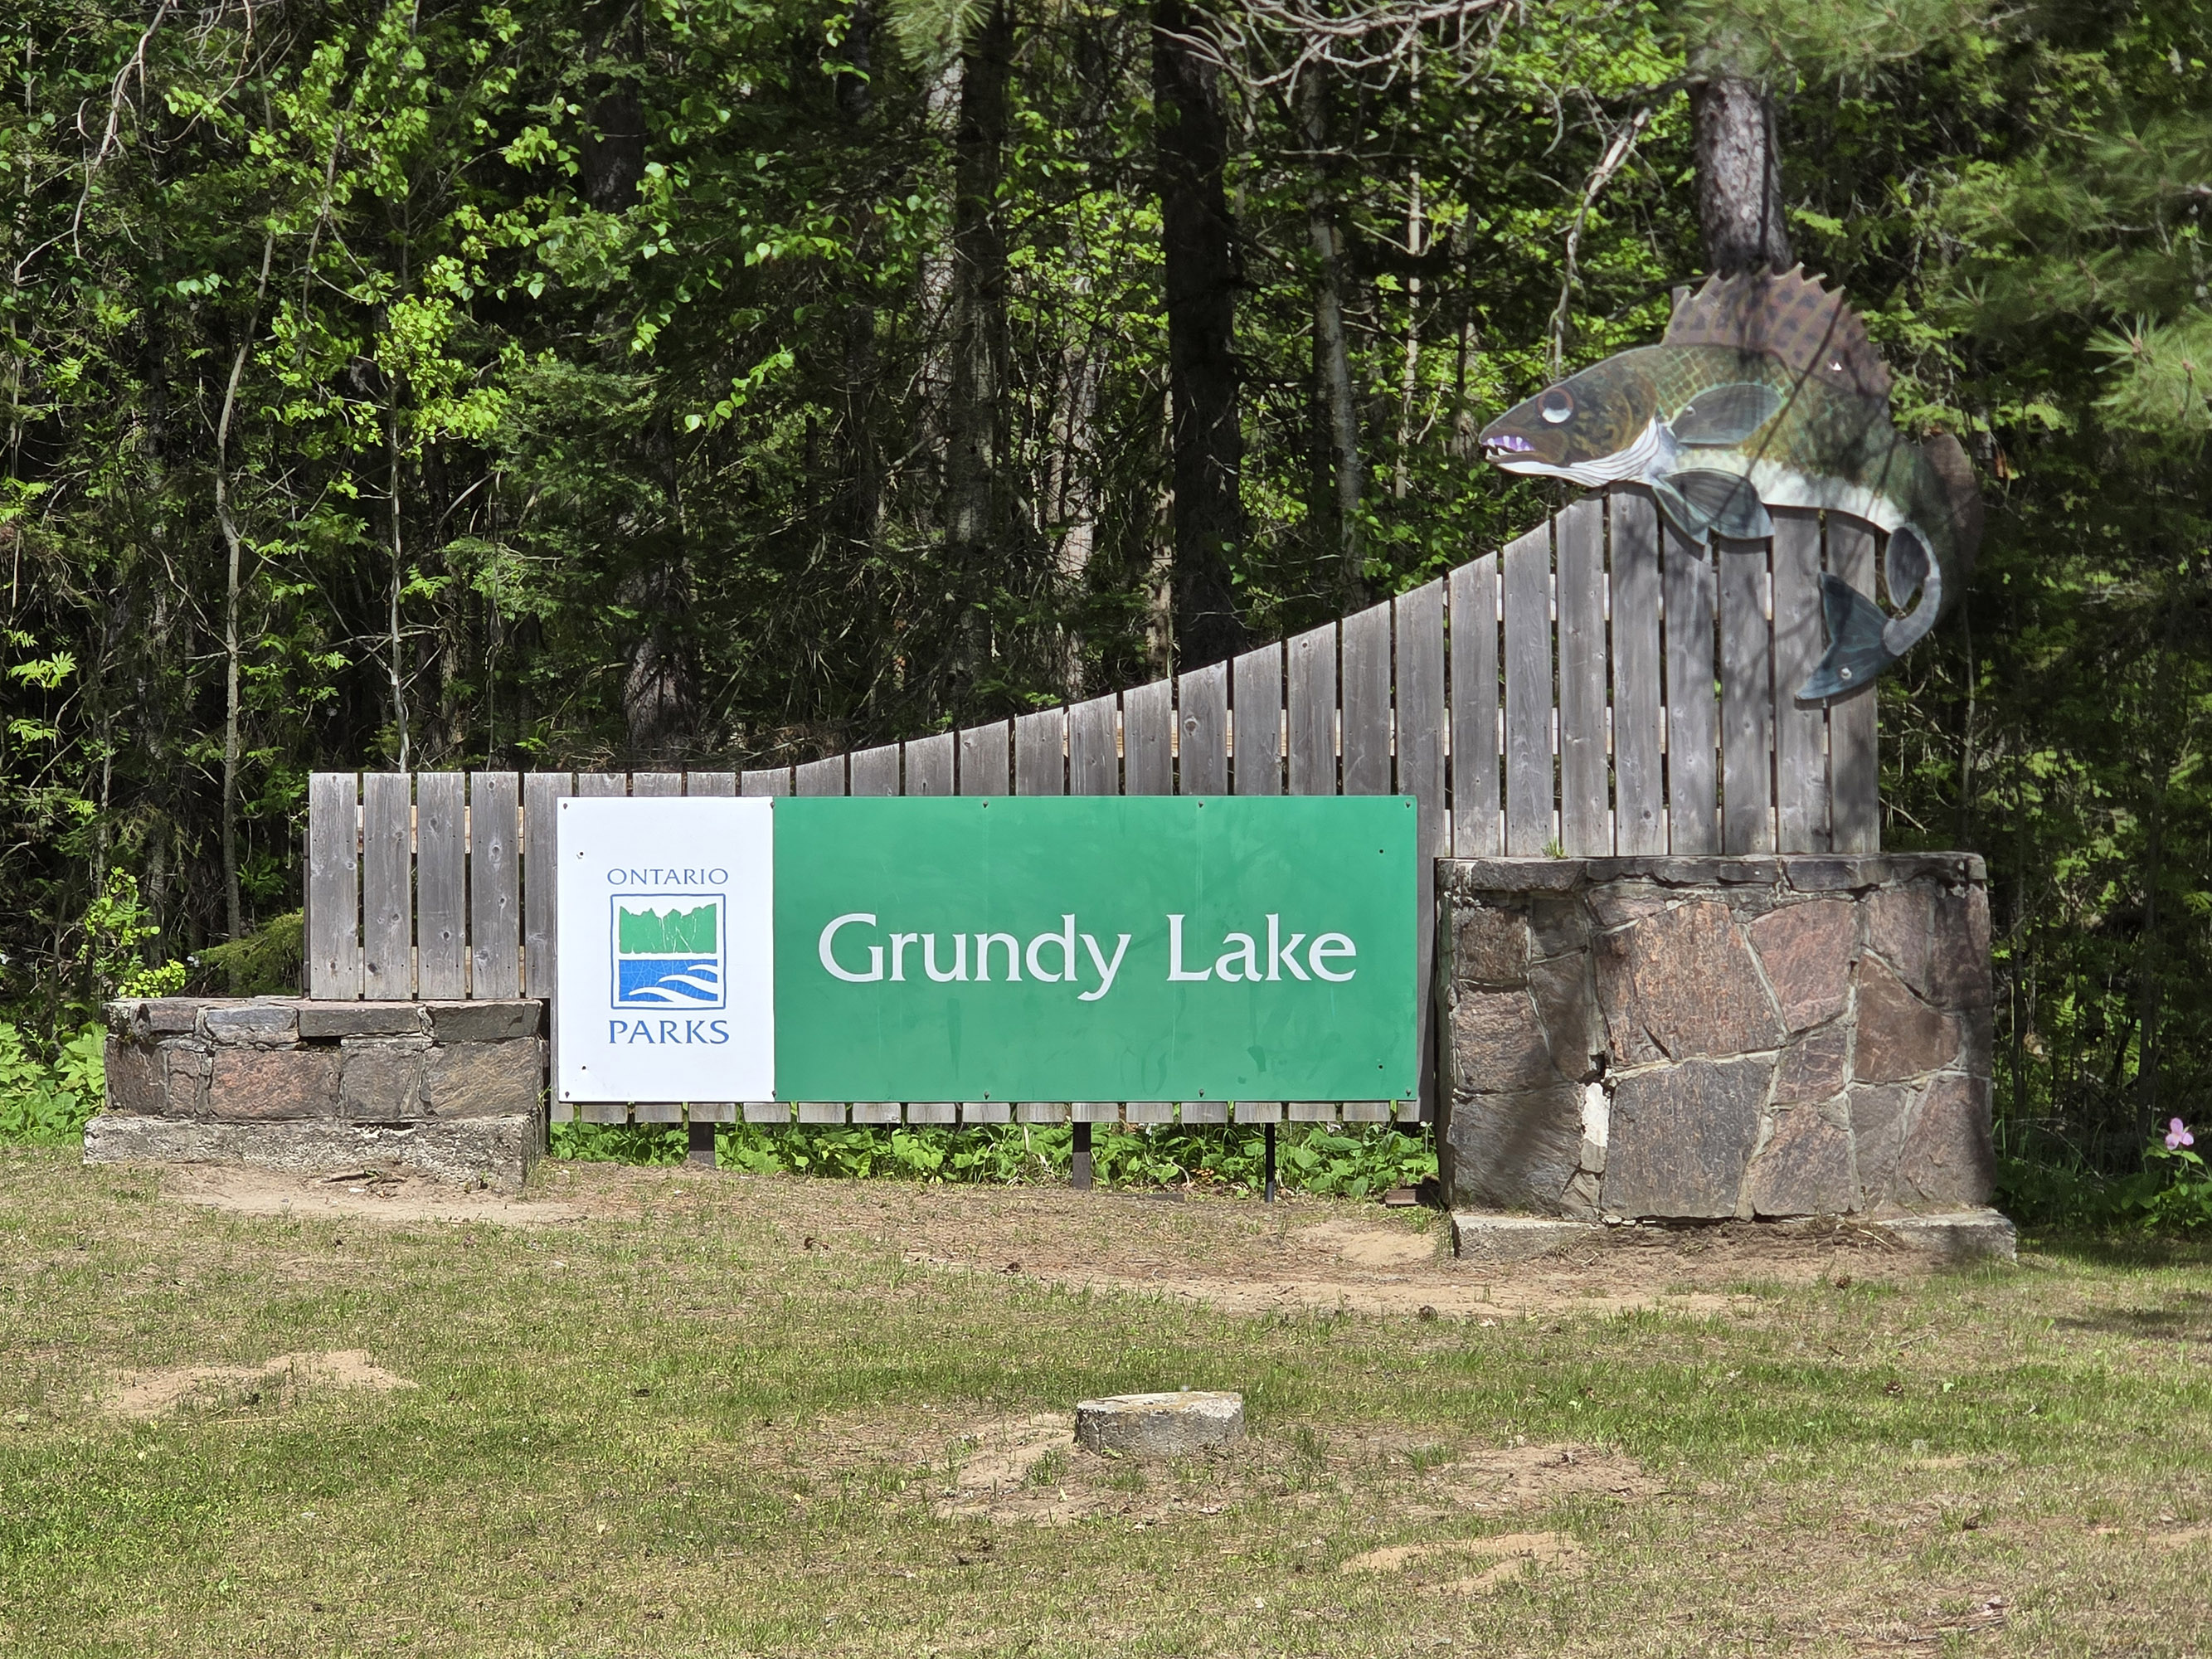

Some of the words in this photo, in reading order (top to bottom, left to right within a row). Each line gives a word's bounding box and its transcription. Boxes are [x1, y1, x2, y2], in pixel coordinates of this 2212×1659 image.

[607, 868, 728, 885] ONTARIO
[819, 912, 1131, 1001] Grundy
[1166, 913, 1357, 982] Lake
[609, 1019, 730, 1044] PARKS
